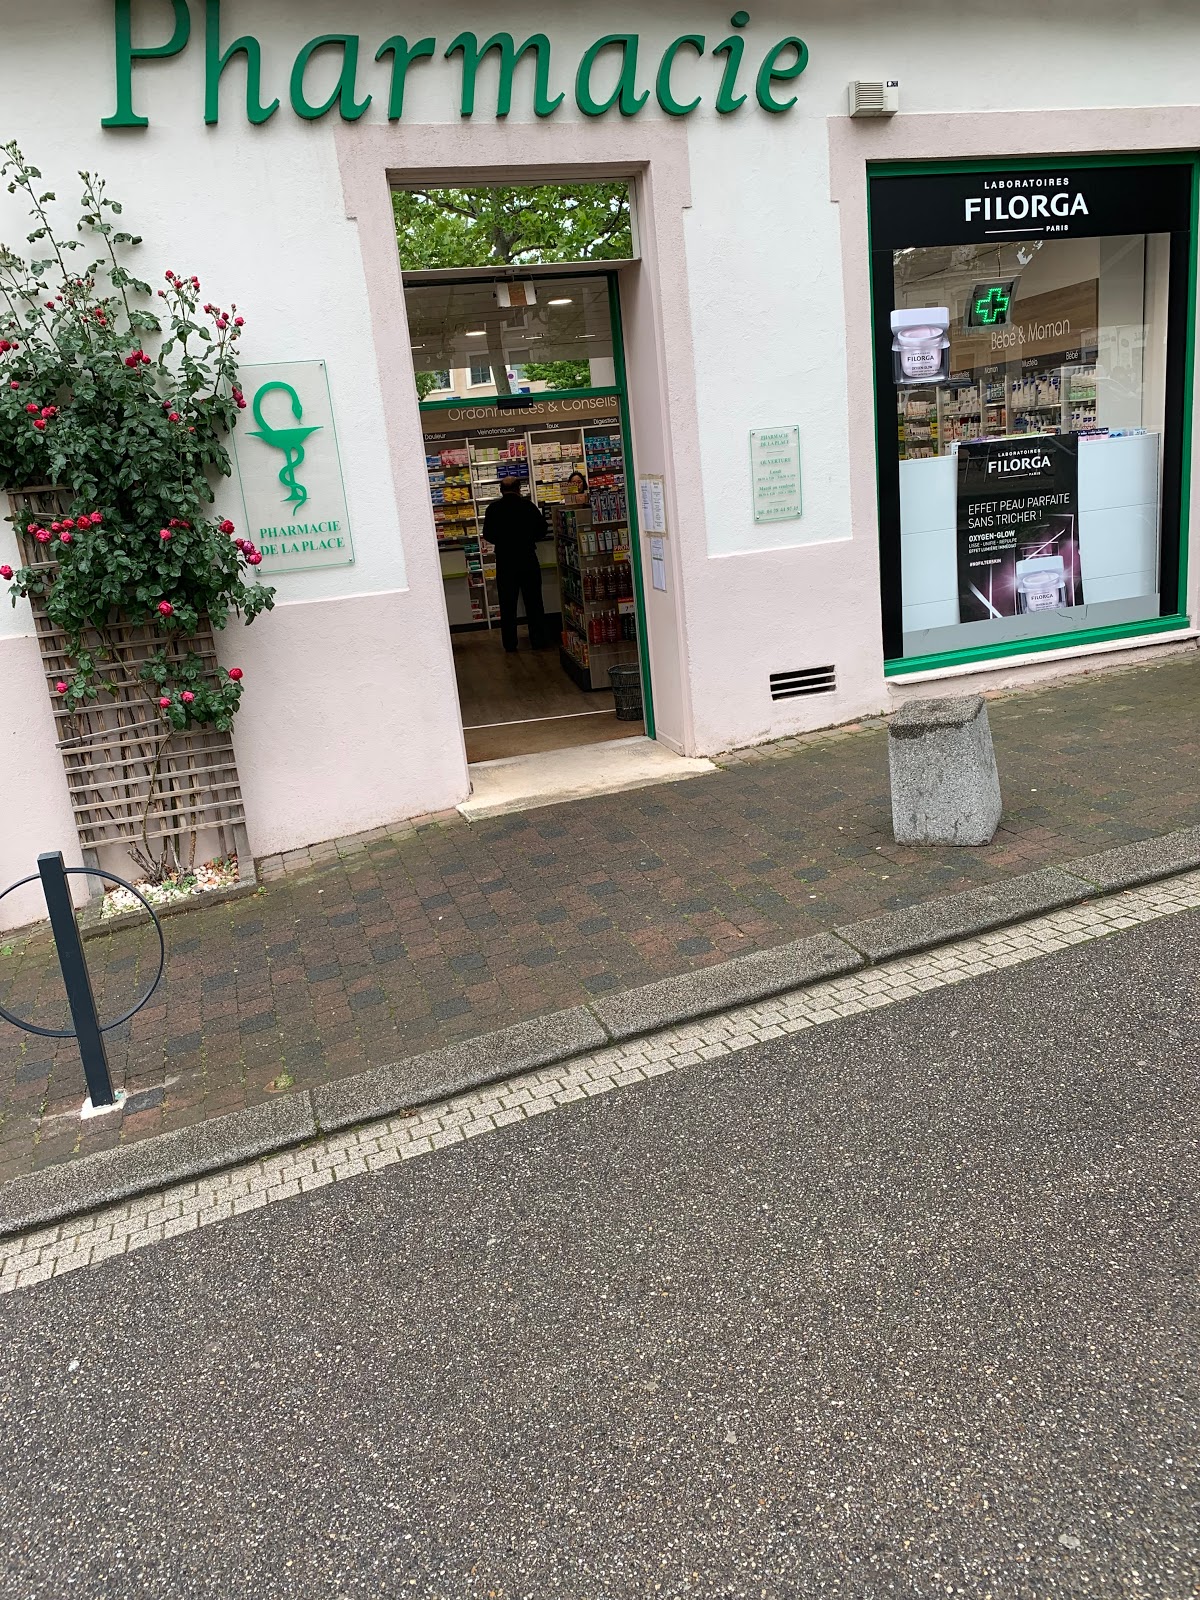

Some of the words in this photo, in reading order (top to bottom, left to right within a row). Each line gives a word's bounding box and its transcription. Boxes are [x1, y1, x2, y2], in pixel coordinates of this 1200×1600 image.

[100, 0, 810, 129] Pharmacie
[984, 177, 1070, 190] LABORATOIRES
[964, 192, 1090, 222] FILORGA
[1045, 224, 1069, 232] PARIS
[991, 327, 1016, 351] Bébé
[1018, 325, 1026, 345] &
[1028, 318, 1070, 343] Maman
[907, 354, 935, 363] FILORGA
[1065, 350, 1079, 361] Bébé
[548, 401, 558, 413] &
[562, 395, 617, 411] Conseils
[424, 433, 447, 441] Douleur
[997, 449, 1041, 458] LABORATOIRES
[988, 456, 1051, 474] FILORGA
[968, 501, 998, 516] EFFET
[999, 498, 1025, 512] PEAU
[1027, 492, 1070, 508] PARFAITE
[968, 515, 994, 529] SANS
[996, 510, 1037, 526] TRICHER
[259, 520, 342, 540] PHARMACIE
[968, 530, 1016, 542] OXYGEN-GLOW
[260, 543, 279, 557] DE
[281, 541, 299, 555] LA
[302, 536, 346, 552] PLACE
